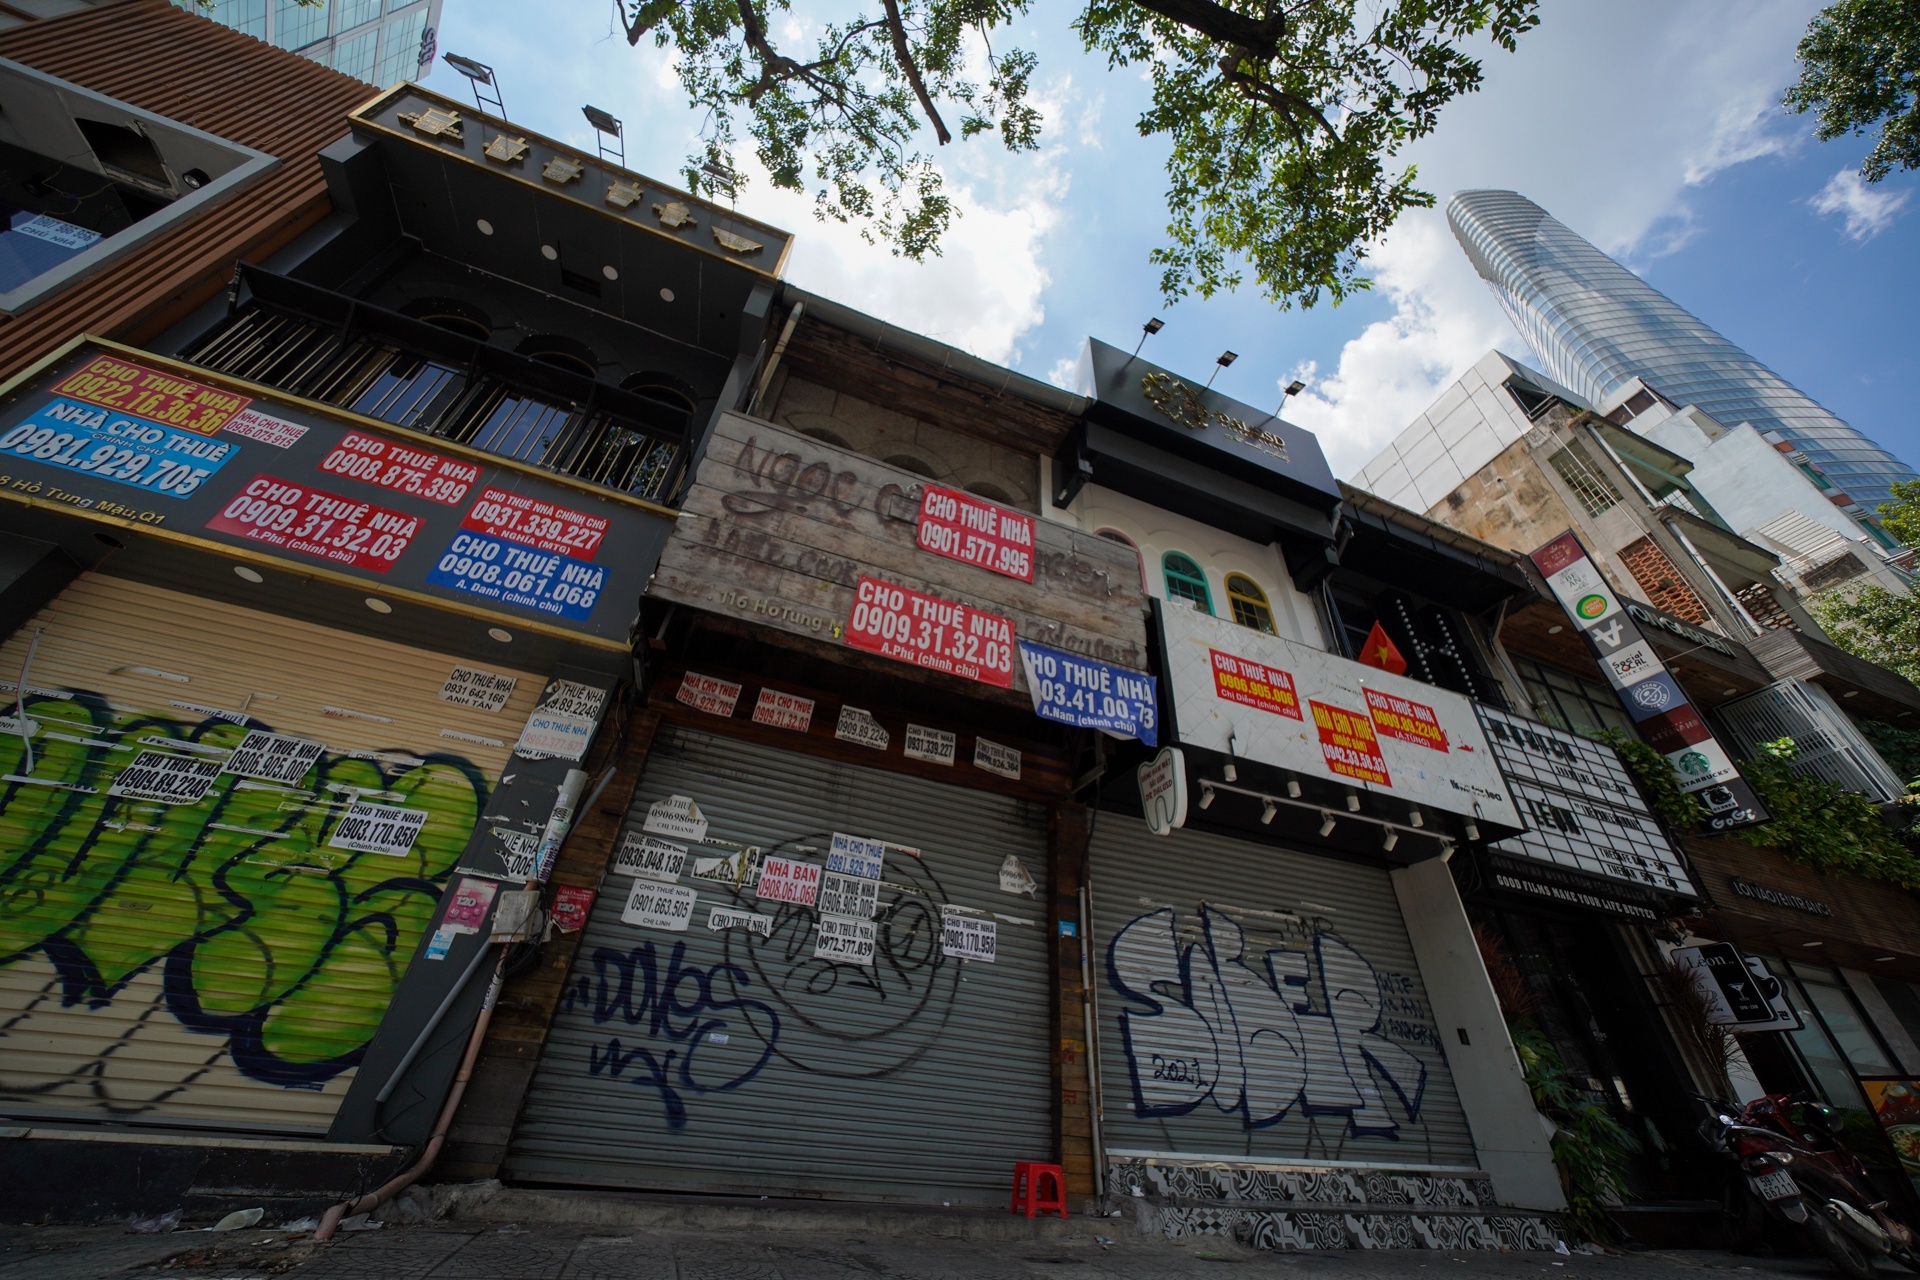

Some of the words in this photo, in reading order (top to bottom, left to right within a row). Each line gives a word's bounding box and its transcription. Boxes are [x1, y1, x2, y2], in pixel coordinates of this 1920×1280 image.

[92, 361, 140, 382] CHO
[145, 373, 199, 399] THUÊ
[193, 388, 242, 413] NHÀ
[61, 372, 228, 435] 0922.16.36.36
[45, 403, 111, 431] NHÀ
[107, 420, 166, 444] CHO
[163, 433, 232, 463] THUÊ
[227, 421, 254, 437] 0936
[250, 427, 273, 442] 075
[271, 433, 294, 449] 915
[237, 411, 258, 426] NHÀ
[257, 418, 280, 431] CHO
[277, 424, 306, 438] THUÊ
[0, 424, 211, 497] 0981.929.705
[341, 435, 385, 456] CHO
[386, 446, 439, 472] THUÊ
[442, 463, 479, 483] NHÀ
[322, 450, 467, 504] 0908.875.399
[12, 479, 44, 494] Hồ
[48, 487, 94, 509] Tung
[484, 489, 506, 503] CHO
[507, 495, 534, 510] THUÊ
[532, 502, 555, 517] NHÀ
[555, 506, 585, 524] CHÍNH
[246, 479, 303, 506] CHO
[303, 493, 370, 524] THUÊ
[367, 512, 419, 539] NHÀ
[924, 491, 957, 522] CHO
[959, 505, 998, 537] THUÊ
[1000, 517, 1032, 547] NHÀ
[223, 495, 407, 562] 0909.31.32.03
[471, 500, 602, 551] 0931.339.227
[246, 528, 286, 545] A.Phú
[286, 538, 328, 557] (chính
[538, 540, 571, 556] (MTG)
[921, 520, 1031, 578] 0901.577.995
[451, 534, 500, 562] CHO
[503, 547, 560, 579] THUÊ
[560, 563, 605, 591] NHÀ
[438, 554, 597, 608] 0908.061.068
[470, 583, 500, 598] Danh
[502, 591, 537, 608] (chính
[857, 581, 905, 611] CHO
[911, 595, 965, 630] THUÊ
[970, 613, 1011, 645] NHÀ
[852, 602, 1013, 674] 0909.31.32.03
[880, 642, 915, 662] A.Phú
[917, 651, 953, 673] (chính
[451, 668, 472, 683] CHO
[471, 673, 496, 689] THUÊ
[495, 678, 513, 693] NHÀ
[1215, 653, 1237, 671] CHO
[1238, 661, 1268, 684] THUÊ
[1268, 670, 1292, 691] NHÀ
[444, 683, 467, 694] 0931
[468, 688, 488, 700] 642
[488, 692, 505, 704] 166
[562, 682, 587, 700] THUÊ
[586, 688, 606, 704] NHÀ
[684, 674, 700, 689] NHÀ
[701, 679, 718, 694] CHO
[720, 683, 739, 699] THUÊ
[1062, 667, 1111, 695] THUÊ
[1116, 676, 1154, 705] NHÀ
[1219, 672, 1295, 706] 0906.905.006
[445, 695, 468, 706] ANH
[677, 686, 734, 718] 0981.929.705
[759, 691, 776, 705] NHÀ
[777, 695, 793, 709] CHO
[793, 700, 814, 714] THUÊ
[1367, 692, 1389, 710] CHO
[1388, 698, 1414, 718] THUÊ
[1413, 706, 1436, 724] NHÀ
[532, 718, 550, 730] CHO
[551, 721, 573, 734] THUÊ
[572, 726, 588, 737] NHÀ
[753, 705, 809, 732] 0909.31.32.03
[840, 708, 857, 721] CHO
[1042, 704, 1075, 722] A.Nam
[1077, 714, 1112, 728] (chính
[1312, 705, 1333, 731] NHÀ
[1333, 710, 1351, 736] CHO
[1350, 715, 1375, 742] THUÊ
[1372, 709, 1442, 741] 0909.89.2248
[837, 720, 889, 745] 0909.89.2248
[907, 727, 921, 736] CHO
[922, 729, 939, 740] THUÊ
[940, 733, 954, 743] NHÀ
[240, 733, 270, 754] CHO
[270, 738, 300, 758] THUÊ
[299, 742, 324, 761] NHÀ
[907, 736, 954, 758] 0931.339.227
[977, 742, 990, 754] CHO
[1322, 742, 1387, 774] 0942.33.58.33
[134, 751, 166, 770] CHO
[164, 756, 199, 774] THUÊ
[193, 762, 223, 779] NHÀ
[1680, 769, 1729, 788] STARBUCKS
[116, 767, 211, 799] 0909.89.2248
[120, 788, 159, 802] Chính
[350, 804, 373, 817] CHO
[374, 807, 403, 822] THUÊ
[402, 811, 425, 826] NHÀ
[335, 816, 418, 849] 0903.170.958
[627, 834, 645, 846] THUÊ
[618, 845, 684, 875] 0936.048.138
[833, 836, 848, 851] NHÀ
[849, 840, 863, 855] CHO
[865, 841, 883, 859] THUÊ
[766, 859, 788, 878] NHÀ
[793, 864, 817, 883] BÁN
[827, 853, 880, 879] 0981.929.705
[639, 883, 654, 892] CHO
[656, 886, 675, 895] THUÊ
[675, 889, 690, 898] NHÀ
[757, 877, 816, 905] 0908.061.068
[825, 876, 840, 892] CHO
[842, 879, 860, 896] THUÊ
[860, 882, 875, 898] NHÀ
[1497, 874, 1522, 890] GOOD
[1522, 880, 1552, 897] FILMS
[1551, 886, 1578, 903] MAKE
[1577, 893, 1602, 908] YOUR
[1601, 899, 1623, 913] LIFE
[1622, 903, 1658, 921] BETTER
[631, 893, 688, 919] 0901.663.505
[821, 891, 874, 918] 0906.905.006
[655, 919, 671, 927] LINH
[712, 914, 730, 928] CHO
[751, 918, 768, 934] NHÀ
[821, 920, 838, 934] CHO
[839, 922, 858, 938] THUÊ
[858, 925, 874, 940] NHÀ
[947, 918, 960, 928] CHO
[962, 920, 979, 931] THUÊ
[980, 923, 995, 934] NHÀ
[818, 935, 873, 957] 0972.377.039
[944, 929, 995, 955] 0903.170.958
[1760, 1172, 1785, 1188] 59-T1
[1763, 1183, 1796, 1199] 662.11
